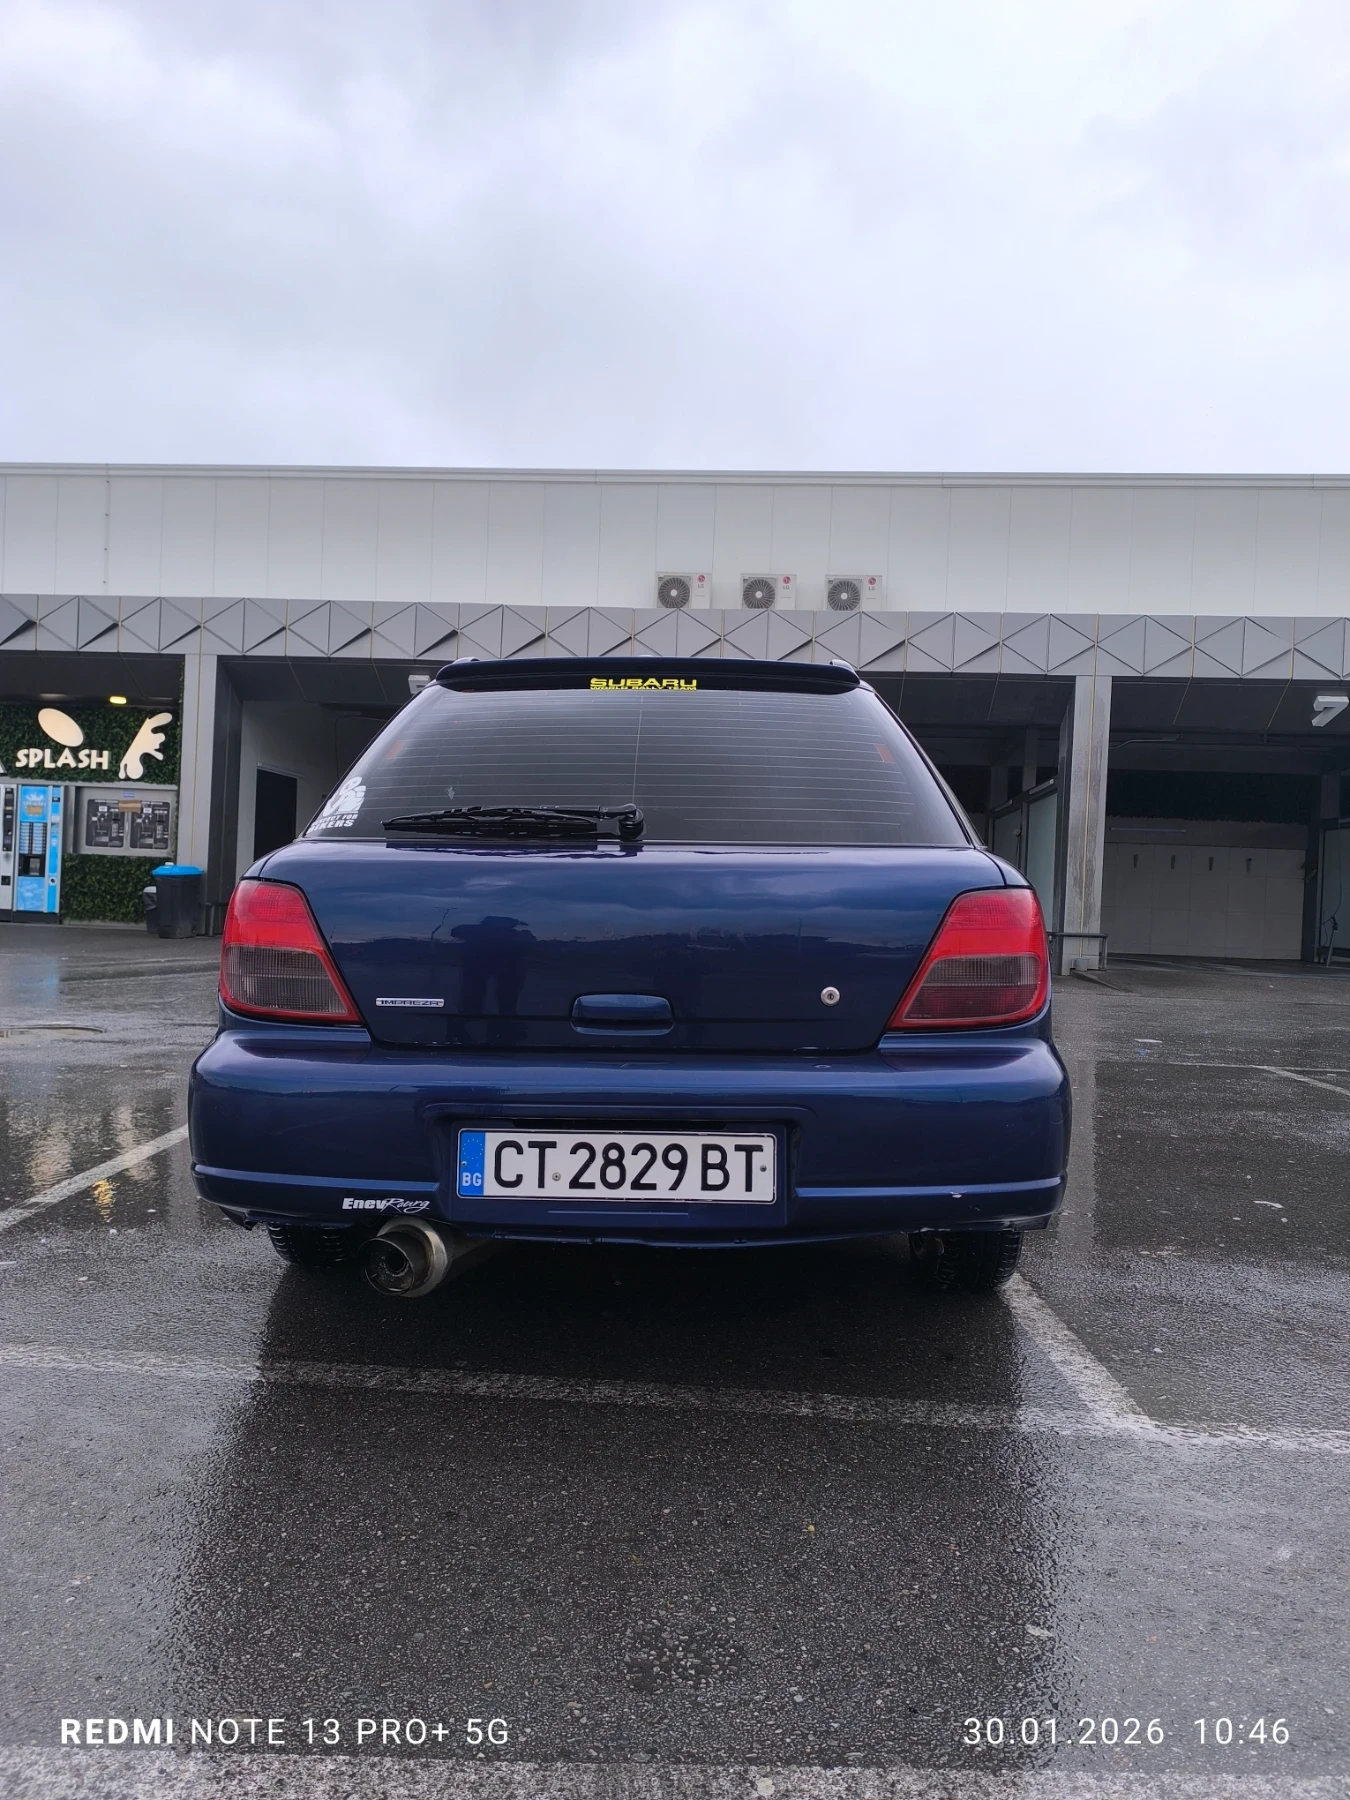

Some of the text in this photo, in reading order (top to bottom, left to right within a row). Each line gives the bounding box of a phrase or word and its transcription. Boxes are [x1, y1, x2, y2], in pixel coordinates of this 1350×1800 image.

[590, 678, 697, 687] SUBARU
[1312, 695, 1349, 727] 7
[15, 748, 109, 770] SPLASH
[493, 1139, 764, 1193] CT 2829 BT
[462, 1172, 482, 1187] BG
